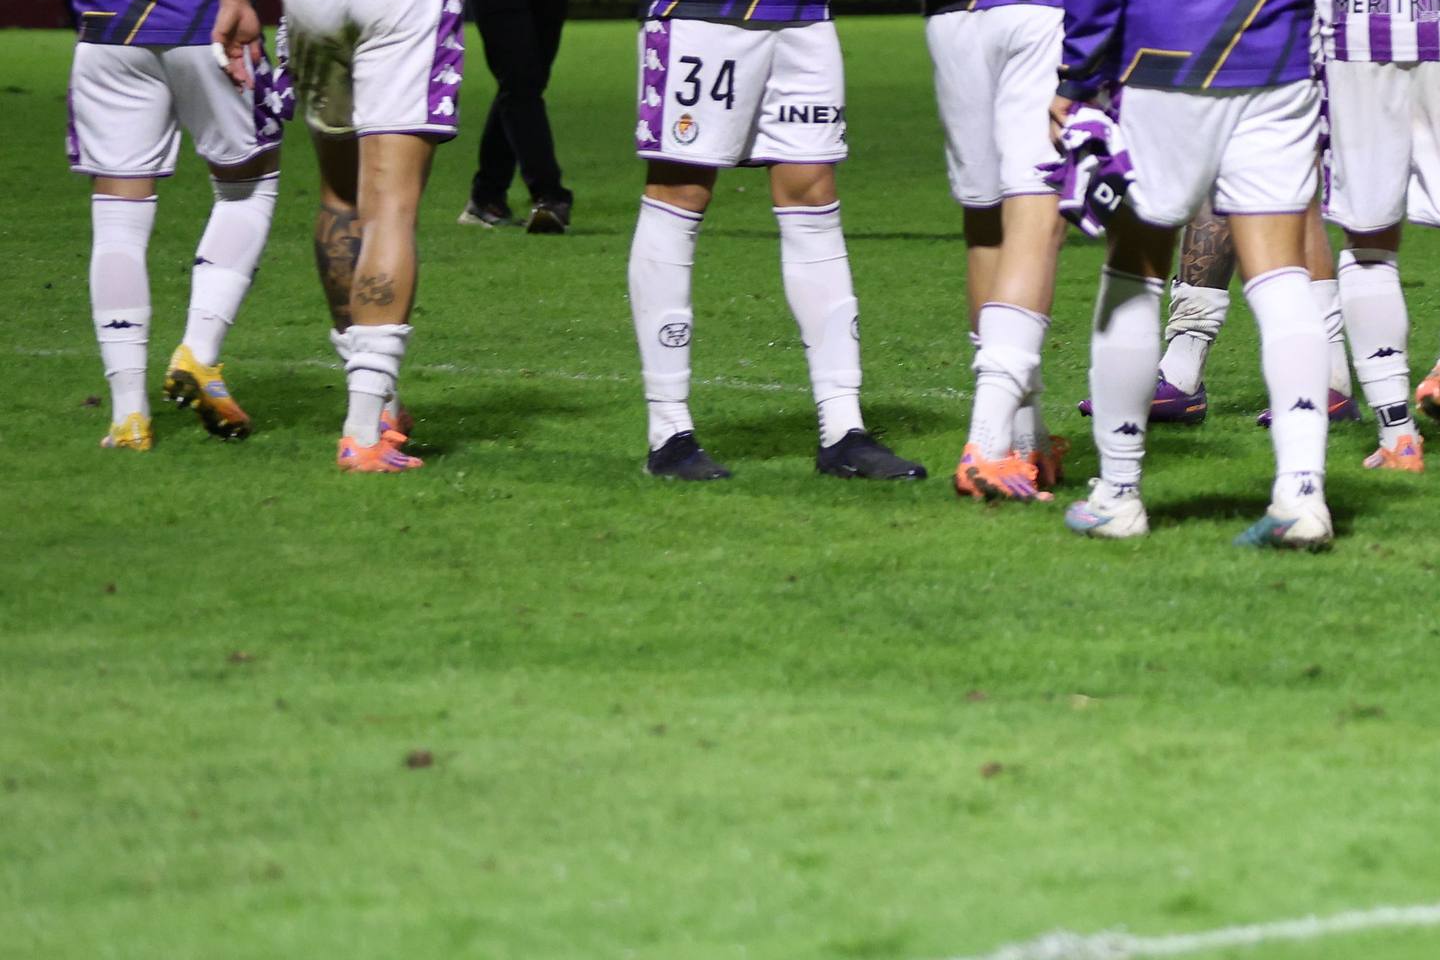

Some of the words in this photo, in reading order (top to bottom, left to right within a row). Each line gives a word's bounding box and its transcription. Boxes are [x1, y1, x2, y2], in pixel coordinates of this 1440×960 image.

[675, 55, 736, 110] 34
[778, 104, 845, 123] INEX
[1094, 182, 1122, 211] DI
